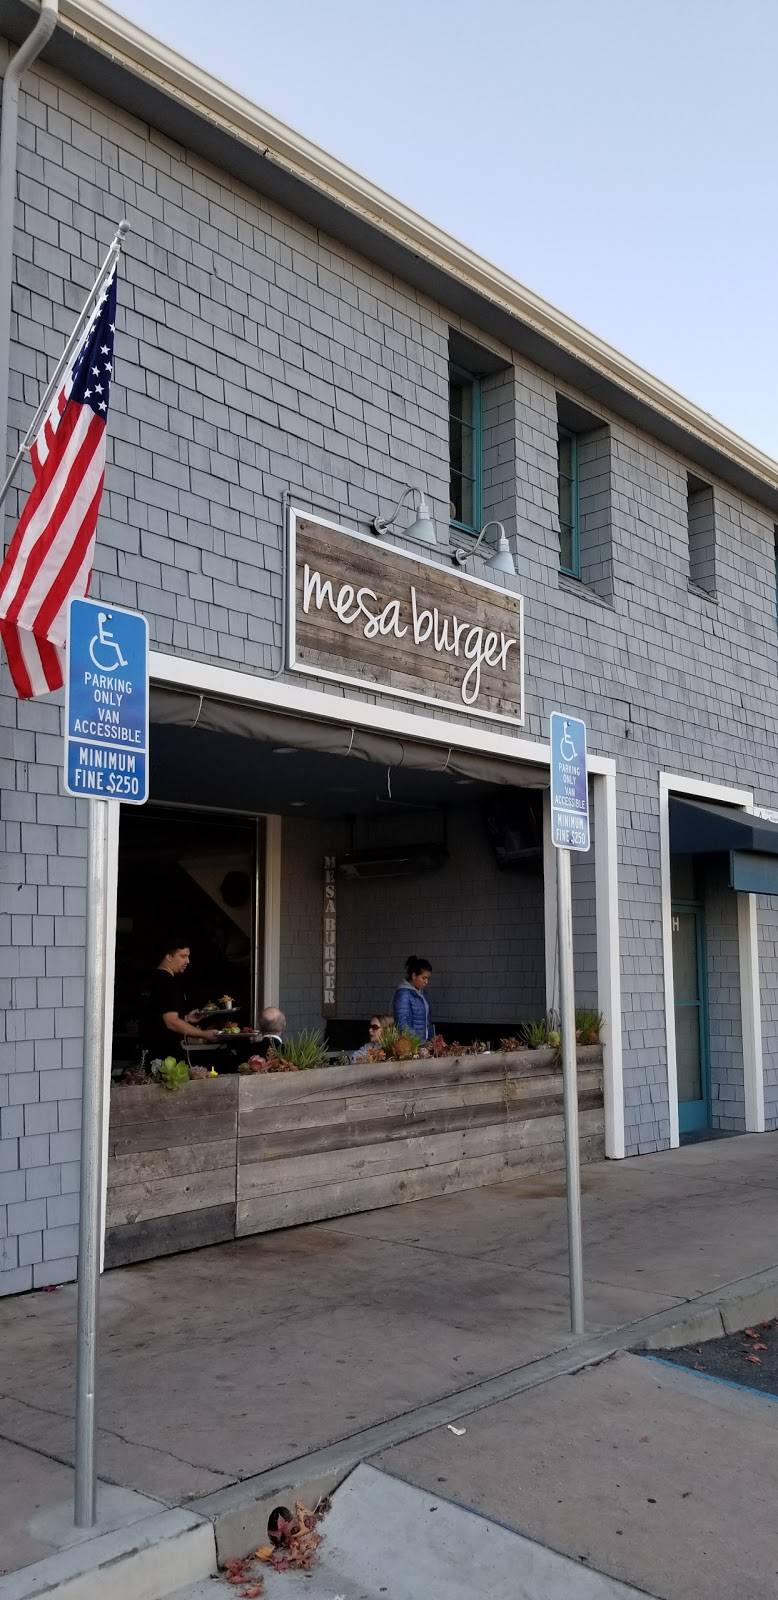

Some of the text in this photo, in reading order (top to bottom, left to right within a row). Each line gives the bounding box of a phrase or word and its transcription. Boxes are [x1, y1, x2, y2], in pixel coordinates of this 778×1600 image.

[303, 564, 516, 705] mesa burger
[84, 671, 133, 694] PARKING
[94, 689, 123, 707] ONLY
[98, 708, 120, 725] VAN
[74, 719, 141, 743] ACCESSIBLE
[79, 747, 136, 773] MINIMUM
[558, 762, 581, 776] PARKING
[75, 768, 139, 795] FINE $250
[562, 775, 576, 785] ONLY
[564, 787, 576, 797] VAN
[554, 796, 586, 810] ACCESSIBLE
[557, 814, 584, 829] MINIMUM
[556, 828, 586, 845] FINE $250
[323, 856, 336, 1004] MESA BURGER
[672, 916, 680, 932] H
